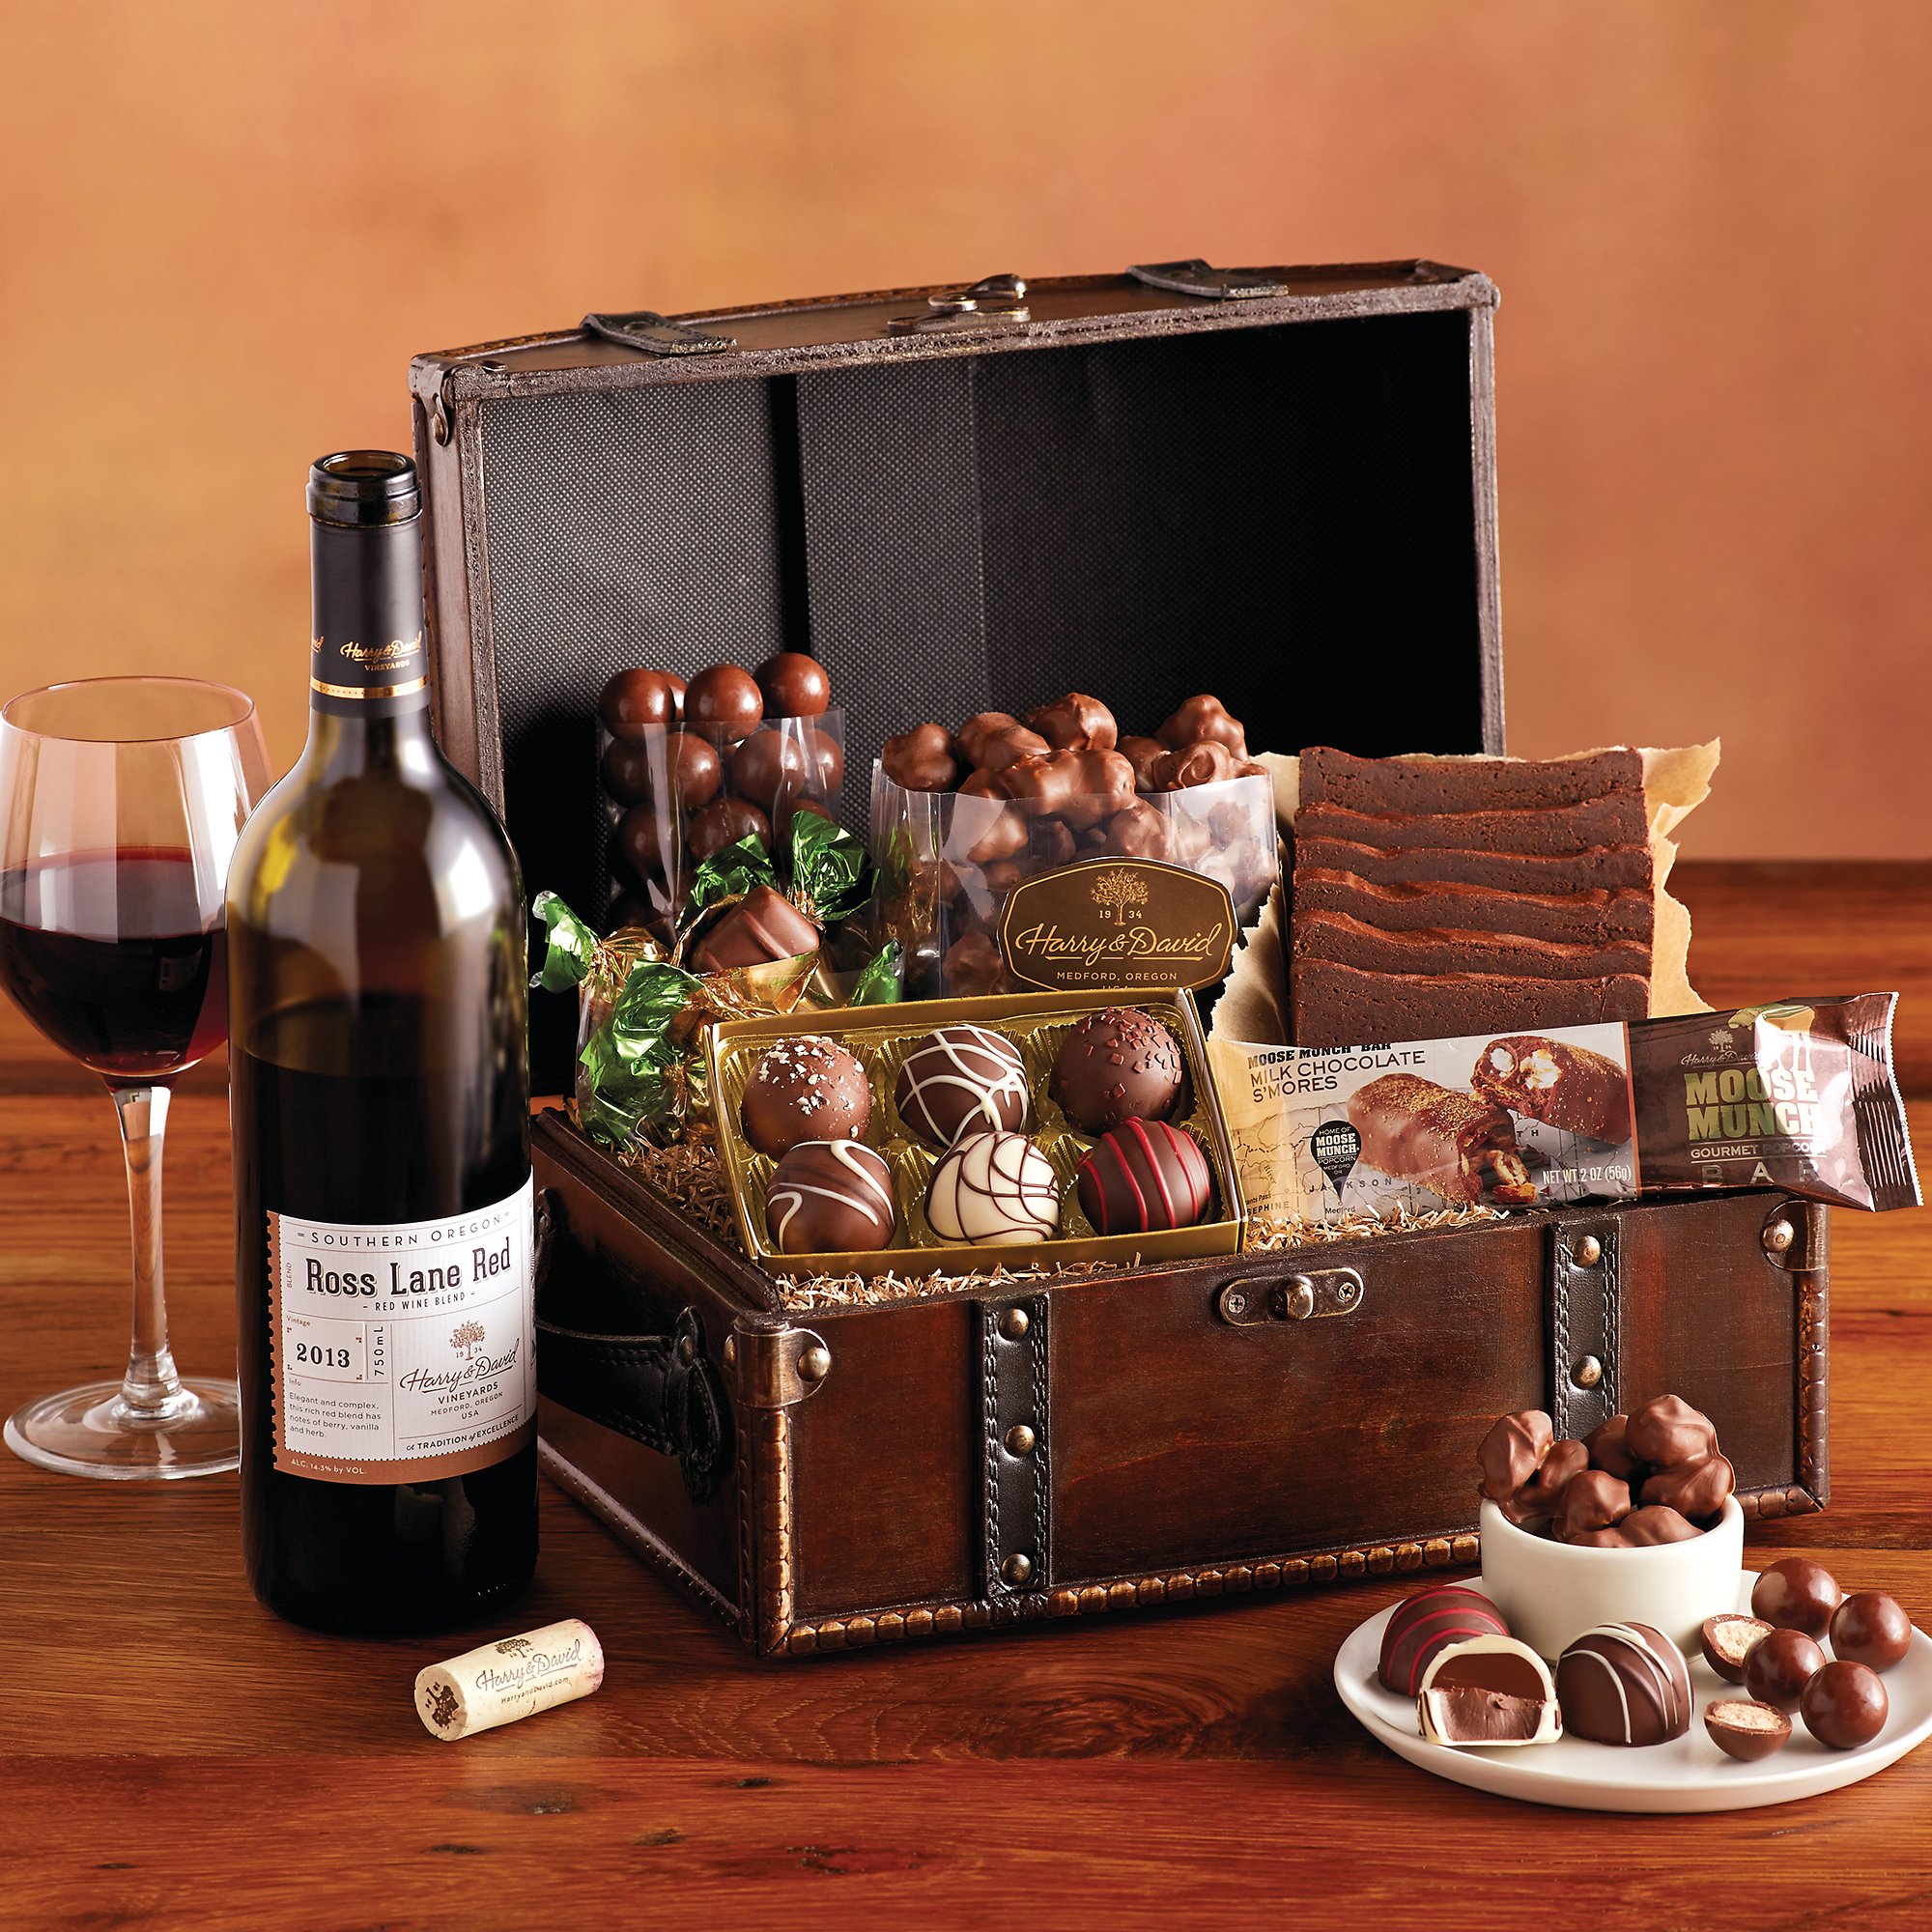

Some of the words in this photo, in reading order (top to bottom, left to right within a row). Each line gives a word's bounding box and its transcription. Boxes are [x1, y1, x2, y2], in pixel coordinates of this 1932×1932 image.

[340, 640, 383, 664] Harry
[364, 659, 411, 671] VINEYARDS
[1098, 910, 1112, 919] 19
[1128, 910, 1143, 919] 34
[1014, 923, 1108, 967] Harry
[1108, 933, 1130, 952] &
[1126, 922, 1223, 956] David
[1057, 971, 1121, 982] MEDFORD,
[1125, 972, 1178, 981] OREGON
[1247, 1049, 1295, 1069] MOOSE
[1250, 1065, 1293, 1088] MILK
[1297, 1050, 1426, 1077] CHOCOLATE
[1253, 1075, 1338, 1103] S'MORES
[1684, 1067, 1819, 1106] MOOSE
[1687, 1101, 1820, 1141] MUNCH
[1316, 1133, 1356, 1147] MOOSE
[1319, 1127, 1341, 1136] HOME
[1318, 1155, 1357, 1165] POPCORN
[1690, 1145, 1759, 1159] GOURMET
[1542, 1170, 1561, 1184] NET
[1579, 1168, 1588, 1182] 2
[1589, 1167, 1603, 1180] OZ
[1604, 1165, 1632, 1183] (56g)
[1701, 1159, 1820, 1187] BAR
[1309, 1178, 1392, 1193] JAKSON
[311, 1232, 417, 1247] SOUTHERN
[431, 1214, 500, 1242] OREGON
[305, 1258, 378, 1298] Ross
[389, 1262, 463, 1298] Lane
[471, 1236, 512, 1285] Red
[375, 1301, 395, 1312] RED
[402, 1298, 429, 1311] WINE
[435, 1292, 466, 1306] BLEND
[286, 1315, 311, 1327] Vintage
[296, 1342, 351, 1368] 2013
[399, 1368, 463, 1393] Harry
[463, 1364, 476, 1379] &
[474, 1337, 520, 1380] David
[288, 1378, 301, 1387] Info
[289, 1392, 319, 1405] Elegant
[321, 1398, 336, 1406] and
[338, 1400, 380, 1410] complex,
[438, 1381, 499, 1405] VINEYARDS
[289, 1404, 303, 1413] this
[304, 1406, 321, 1415] rich
[322, 1409, 336, 1418] red
[338, 1409, 364, 1420] blend
[430, 1403, 473, 1416] MEDFORD,
[474, 1391, 504, 1406] OREGON
[290, 1414, 311, 1425] notes
[323, 1419, 349, 1431] berry,
[350, 1422, 380, 1431] vanilla
[461, 1409, 479, 1420] USA
[290, 1425, 304, 1435] and
[417, 1435, 468, 1450] TRADITION
[469, 1433, 476, 1441] of
[476, 1413, 520, 1437] EXCELLENCE
[333, 1465, 344, 1475] by
[475, 1668, 526, 1691] Harry
[532, 1638, 582, 1674] David
[500, 1676, 569, 1704] HarryandDavid.com
